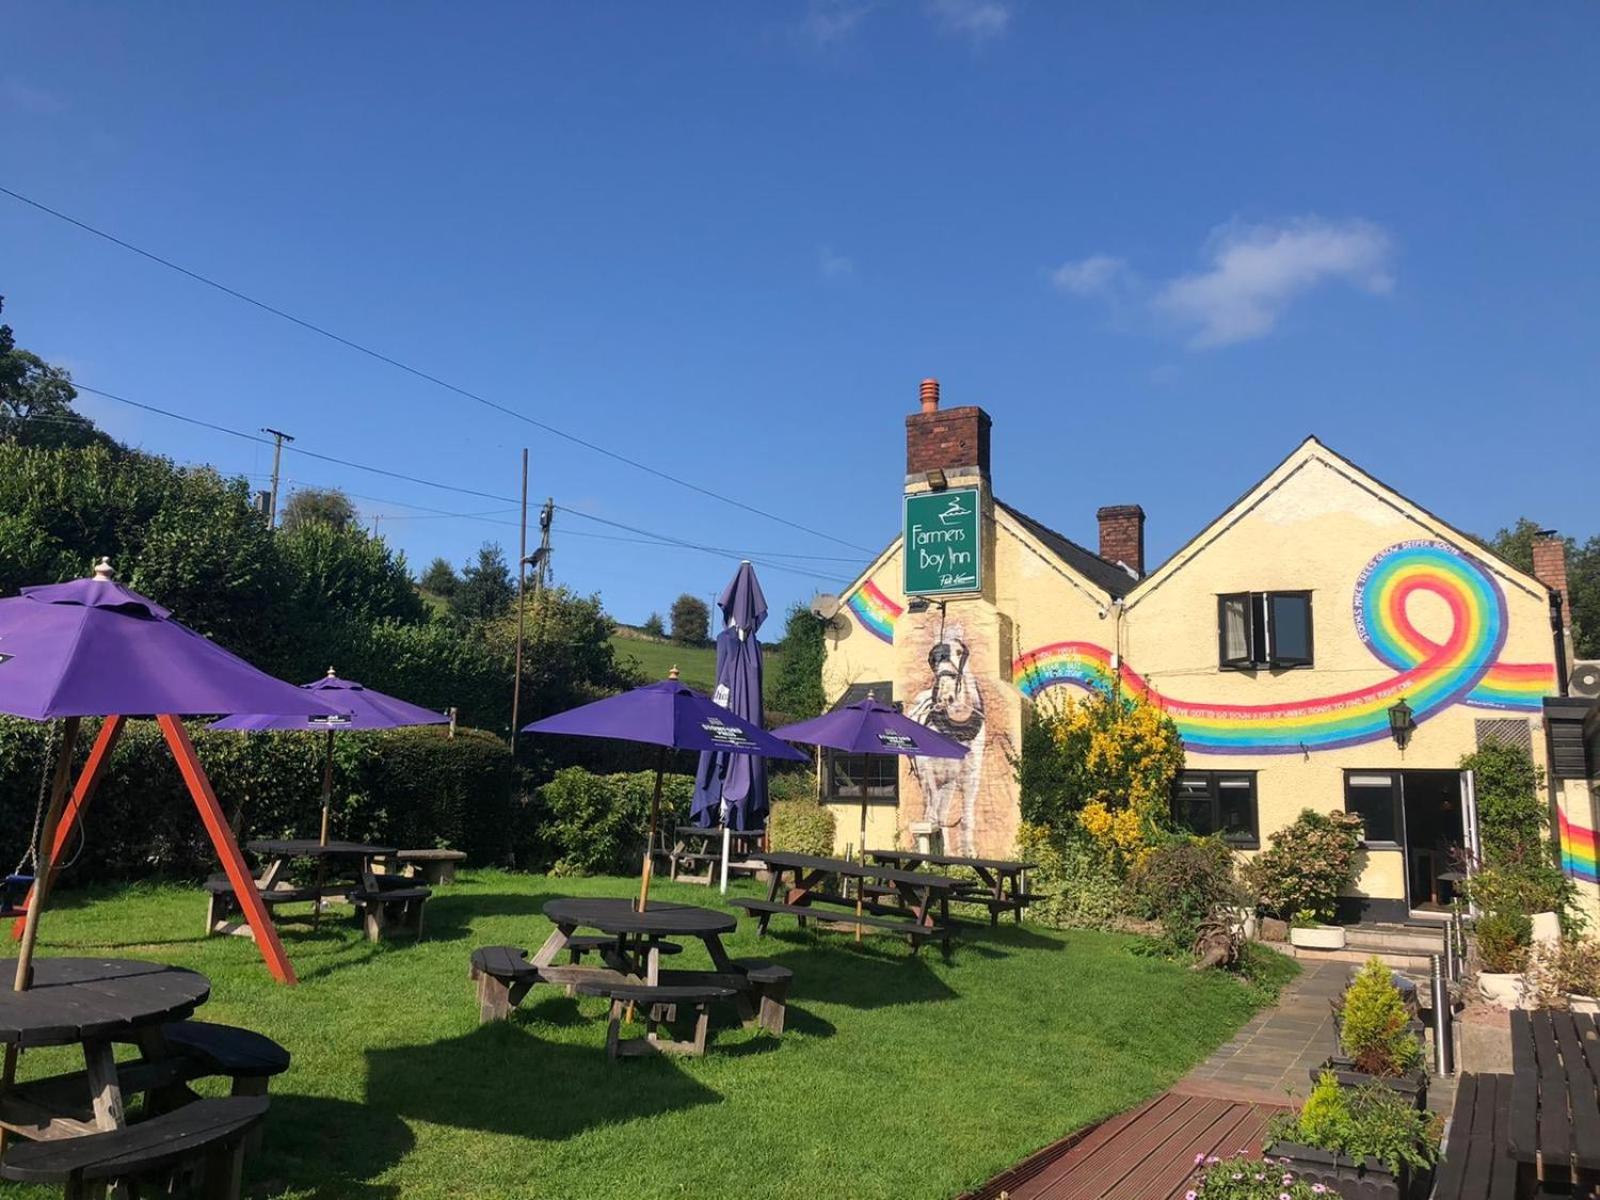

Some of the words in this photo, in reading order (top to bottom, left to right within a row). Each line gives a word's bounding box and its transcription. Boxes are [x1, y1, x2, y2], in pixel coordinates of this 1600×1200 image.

[912, 524, 966, 551] Farmers
[919, 548, 945, 573] Boy
[947, 546, 971, 572] Inn
